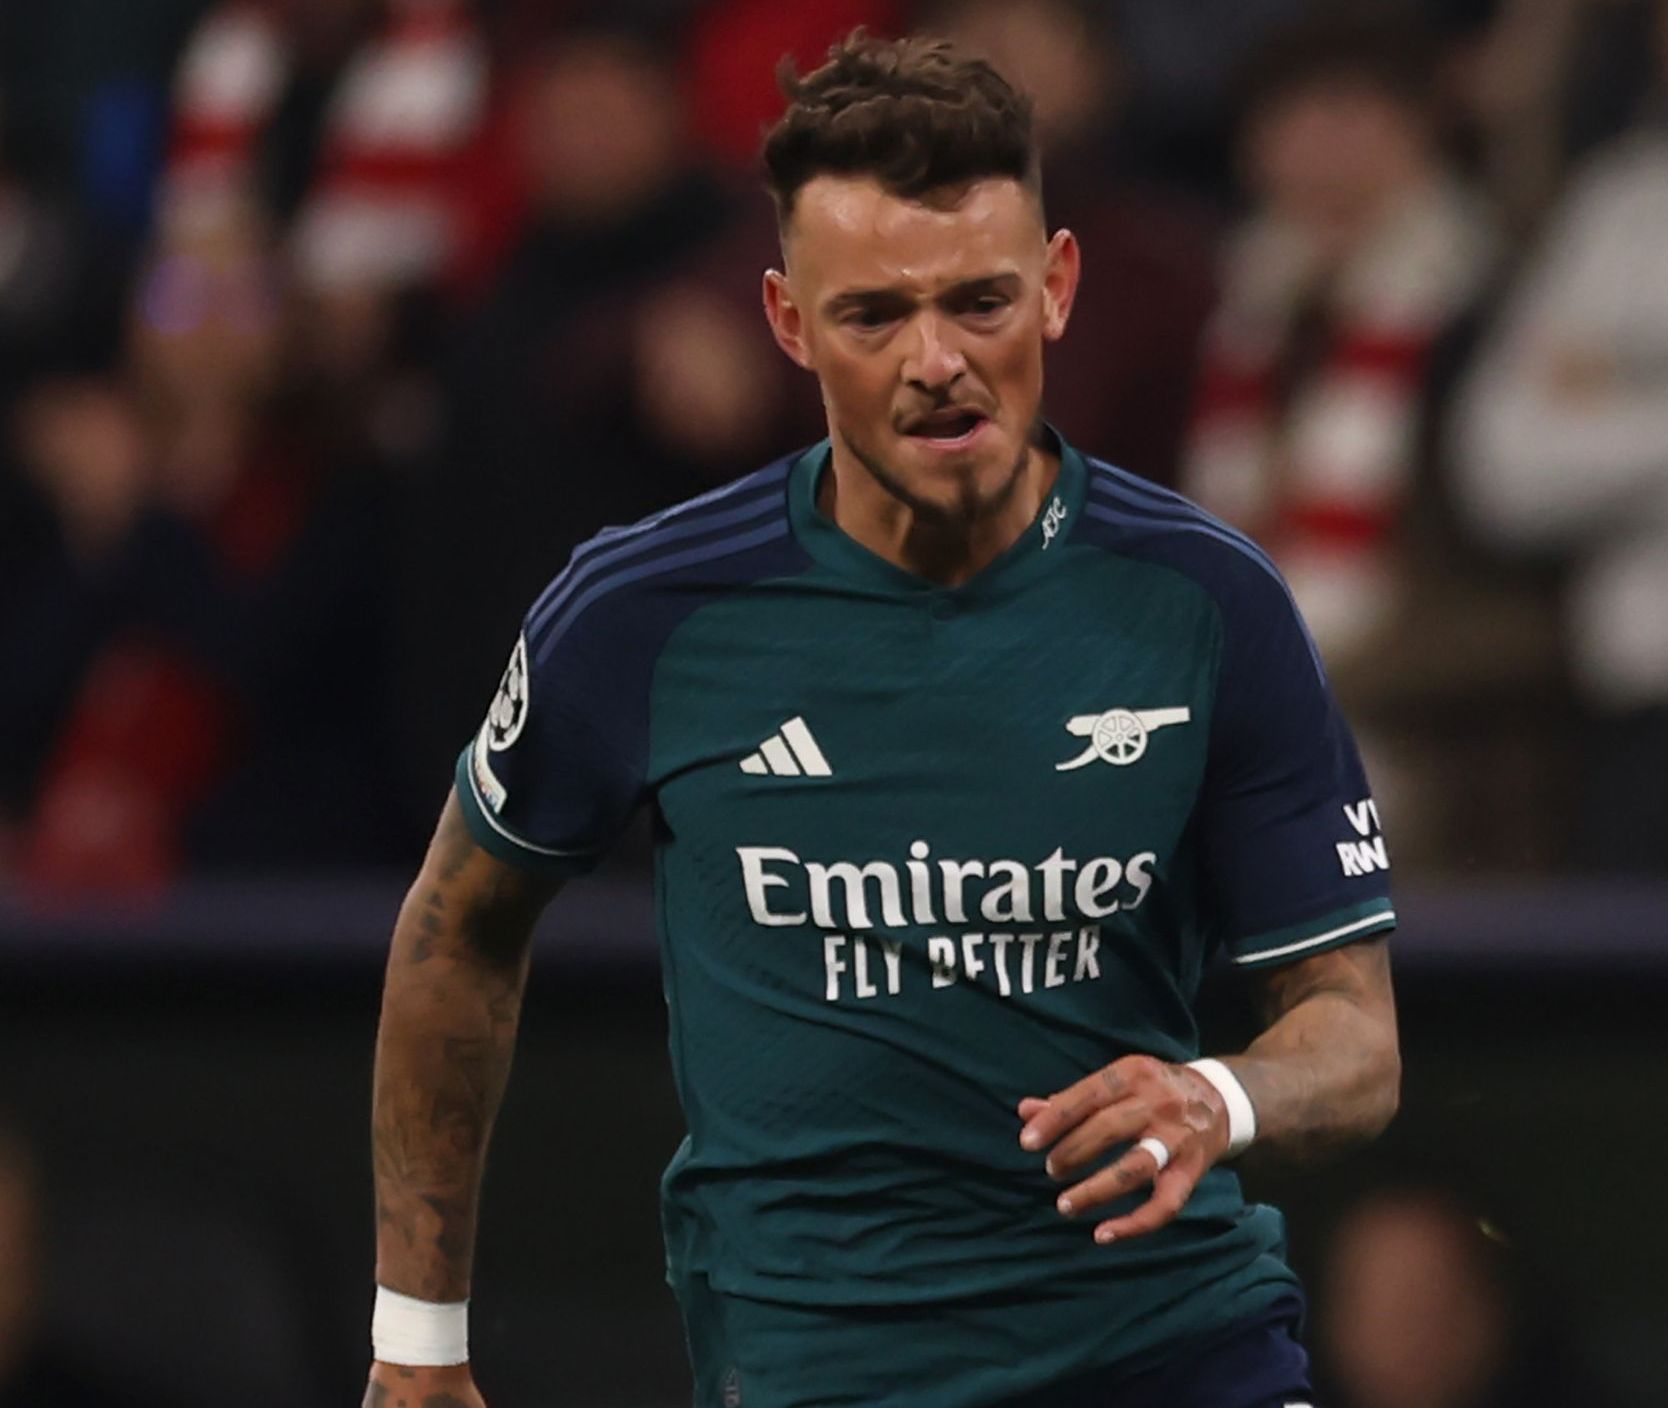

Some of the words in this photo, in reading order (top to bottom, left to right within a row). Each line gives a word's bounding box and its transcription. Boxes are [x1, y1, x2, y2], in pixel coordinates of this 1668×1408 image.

[1343, 799, 1381, 836] VI
[736, 840, 1157, 928] Emirates
[1335, 836, 1390, 876] RW
[824, 933, 901, 1000] FLY
[928, 925, 1101, 996] BETTER
